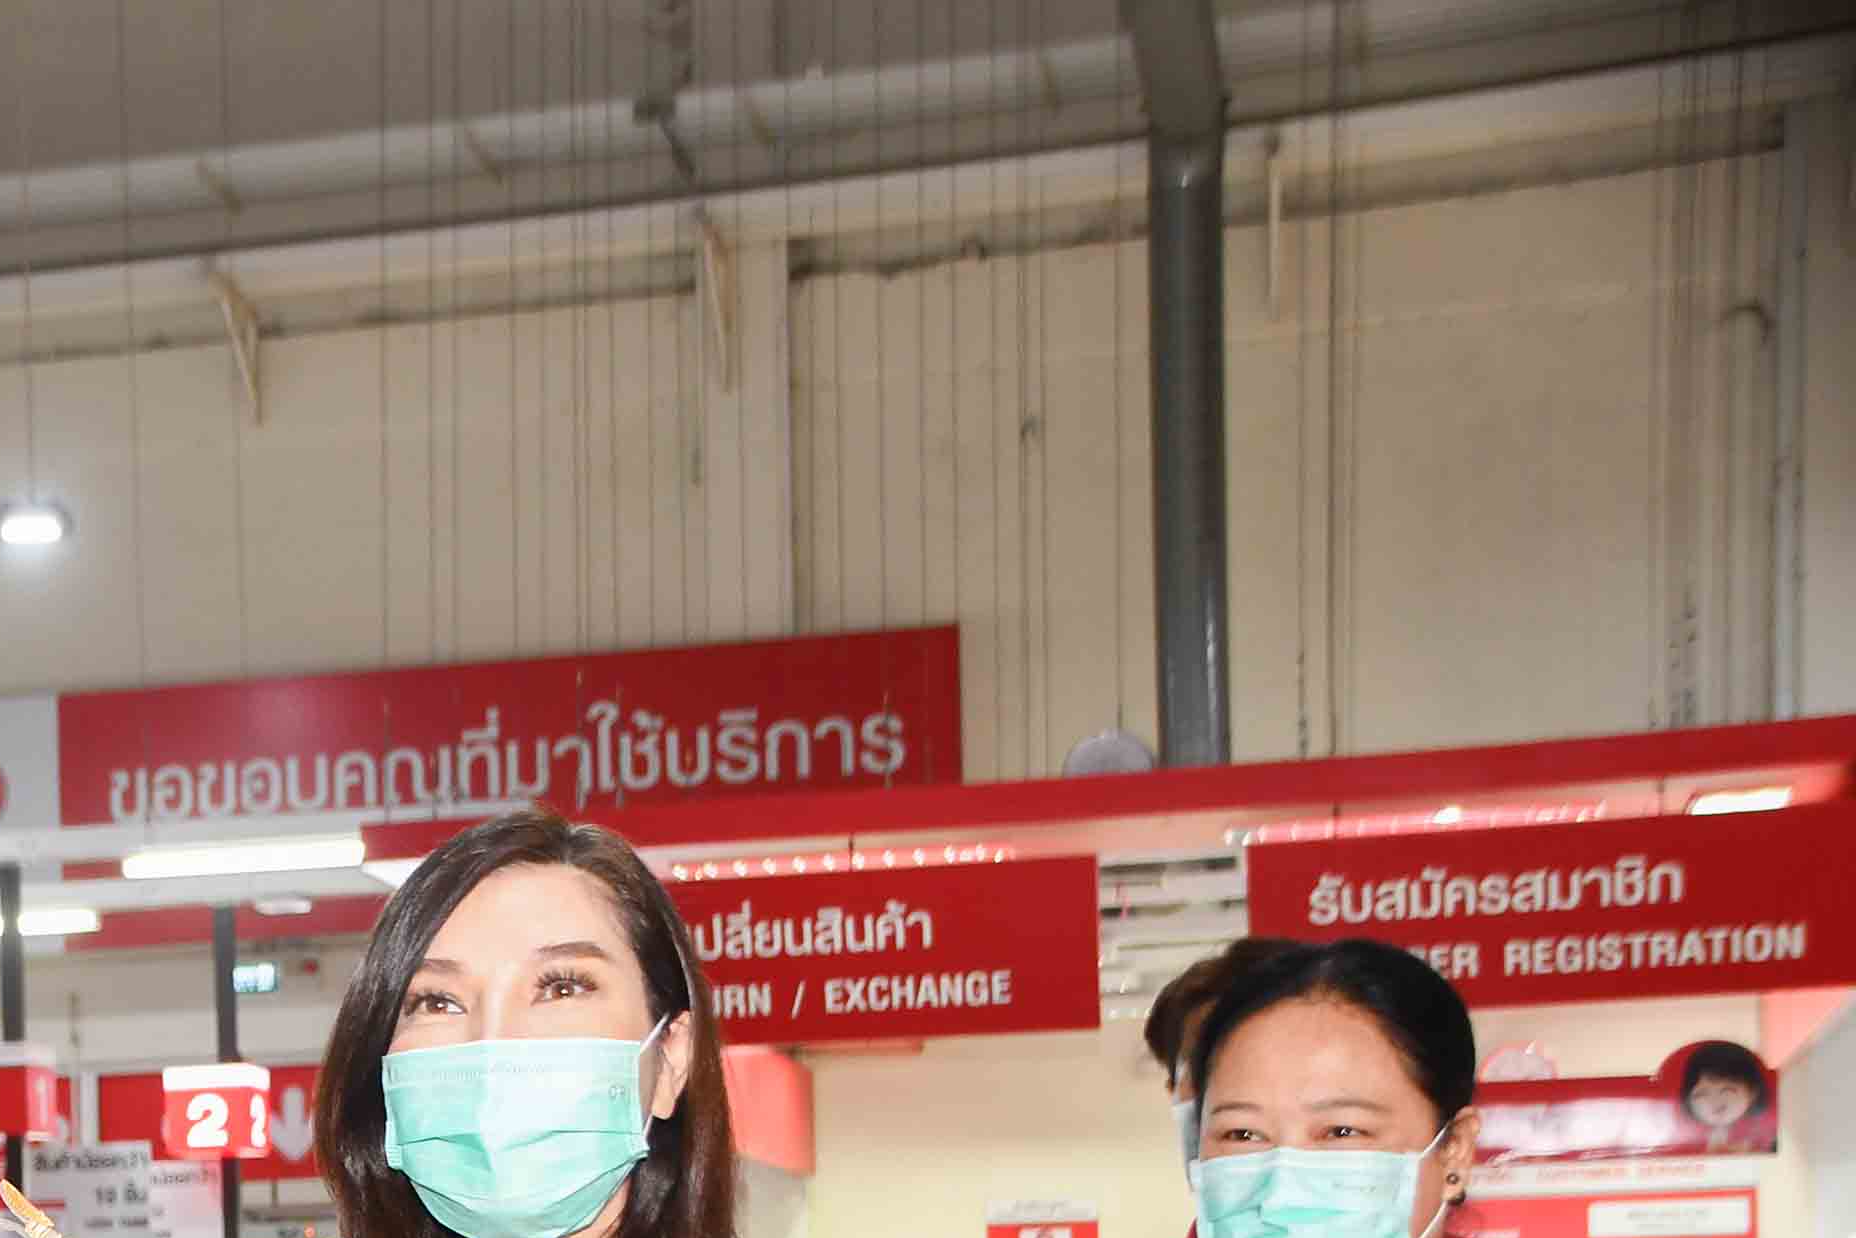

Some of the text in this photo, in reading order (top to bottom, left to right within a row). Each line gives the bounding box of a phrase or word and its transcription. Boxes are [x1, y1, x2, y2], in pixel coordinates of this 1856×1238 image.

[109, 700, 905, 822] ขอขอบคณที่มาใช้บริการ
[686, 899, 933, 960] ปลี่ยนสินค้า
[1503, 924, 1808, 978] REGISTRATION
[824, 968, 1012, 1014] EXCHANGE
[187, 1093, 229, 1148] 2
